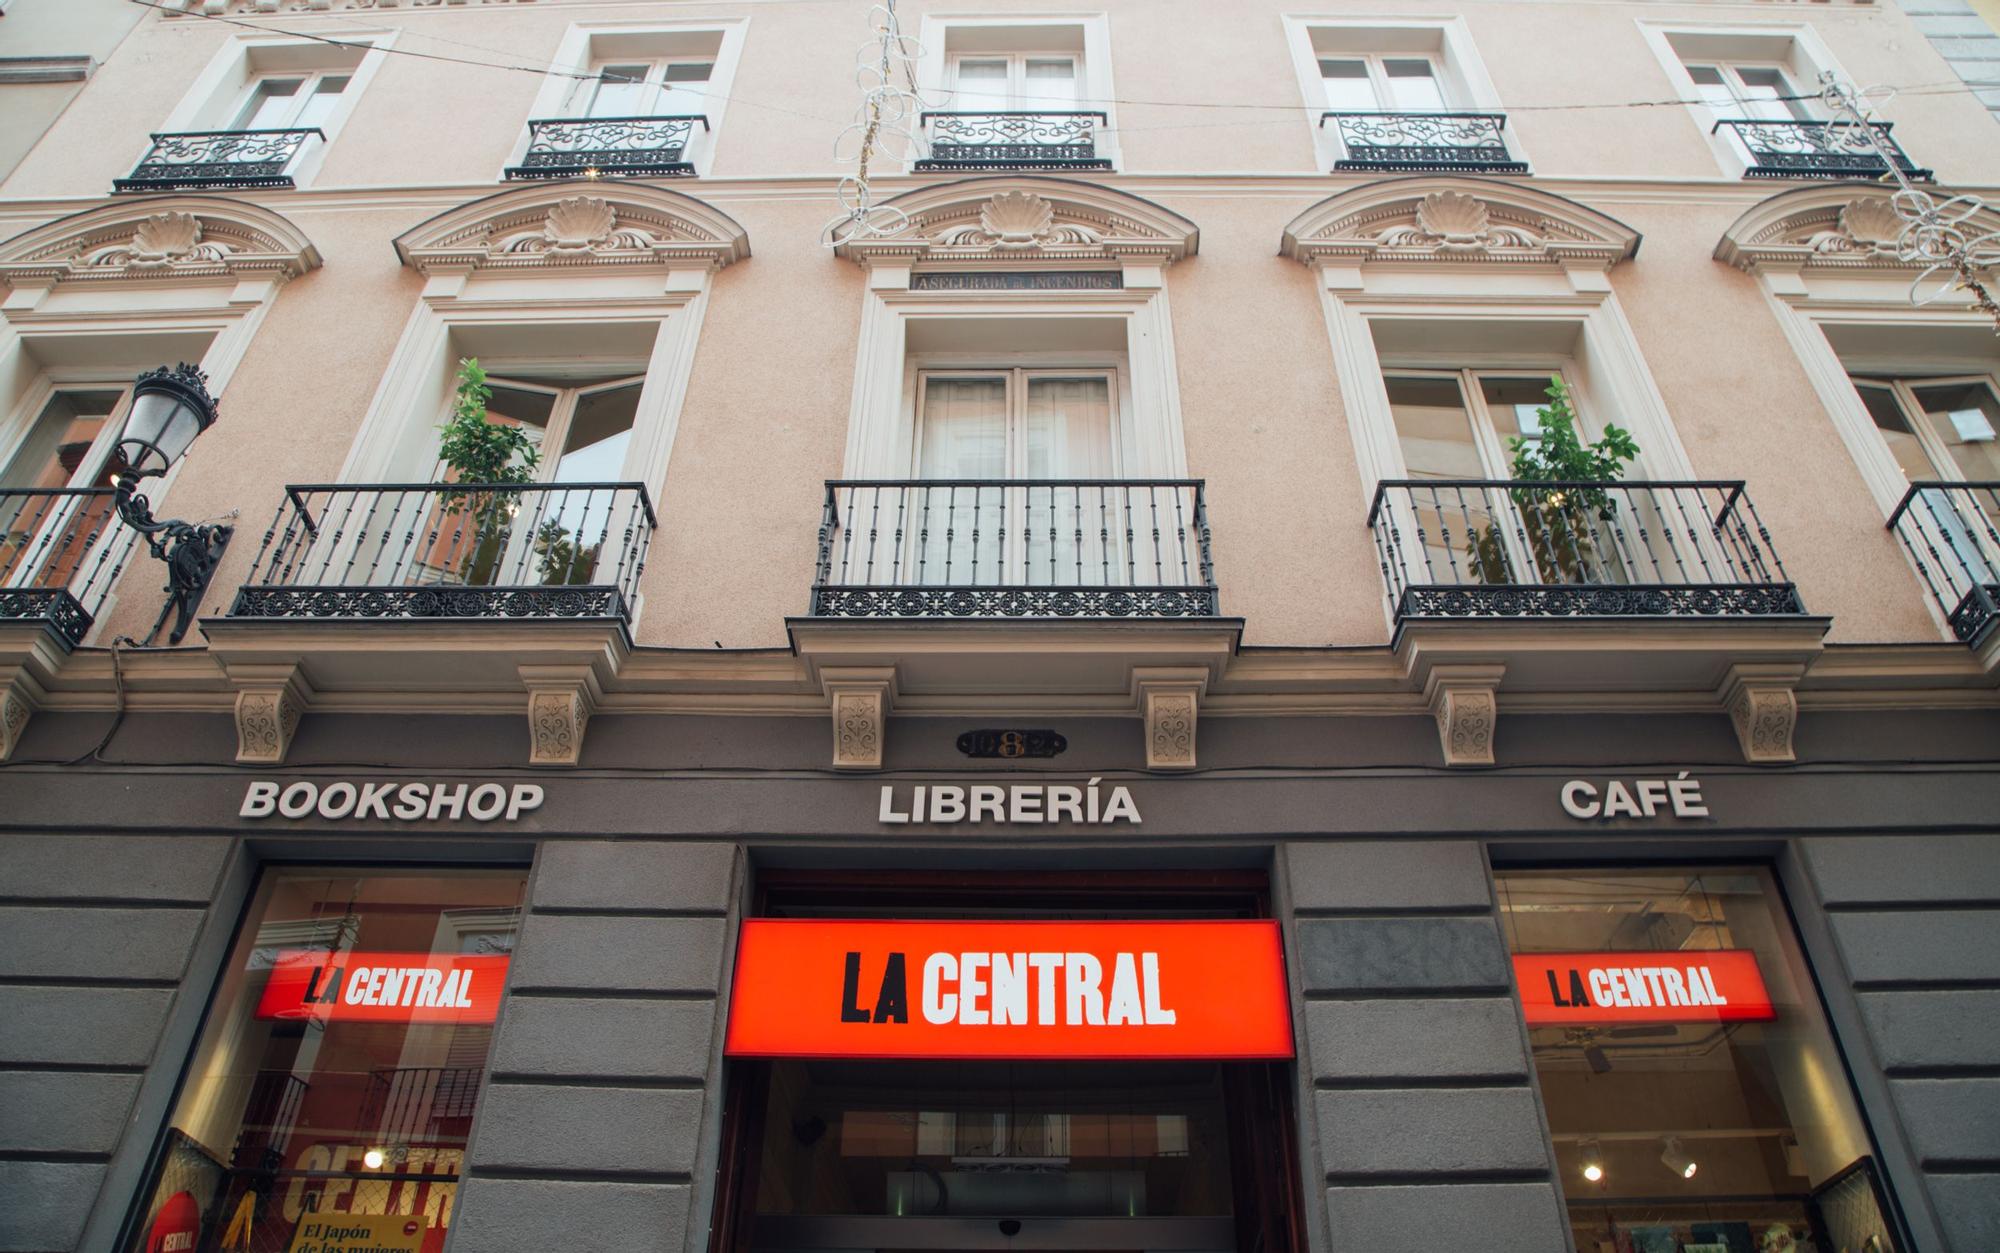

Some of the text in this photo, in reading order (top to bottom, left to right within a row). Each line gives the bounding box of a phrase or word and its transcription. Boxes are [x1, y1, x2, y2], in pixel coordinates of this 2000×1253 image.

[239, 781, 545, 820] BOOKSHOP
[878, 777, 1143, 824] LIBRERÍA
[1561, 771, 1709, 819] CAFÉ
[303, 966, 474, 1008] LA CENTRAL
[841, 951, 1177, 1026] LA CENTRAL
[1546, 966, 1728, 1008] LA CENTRAL
[303, 1224, 371, 1242] El Japón
[322, 1243, 345, 1253] las
